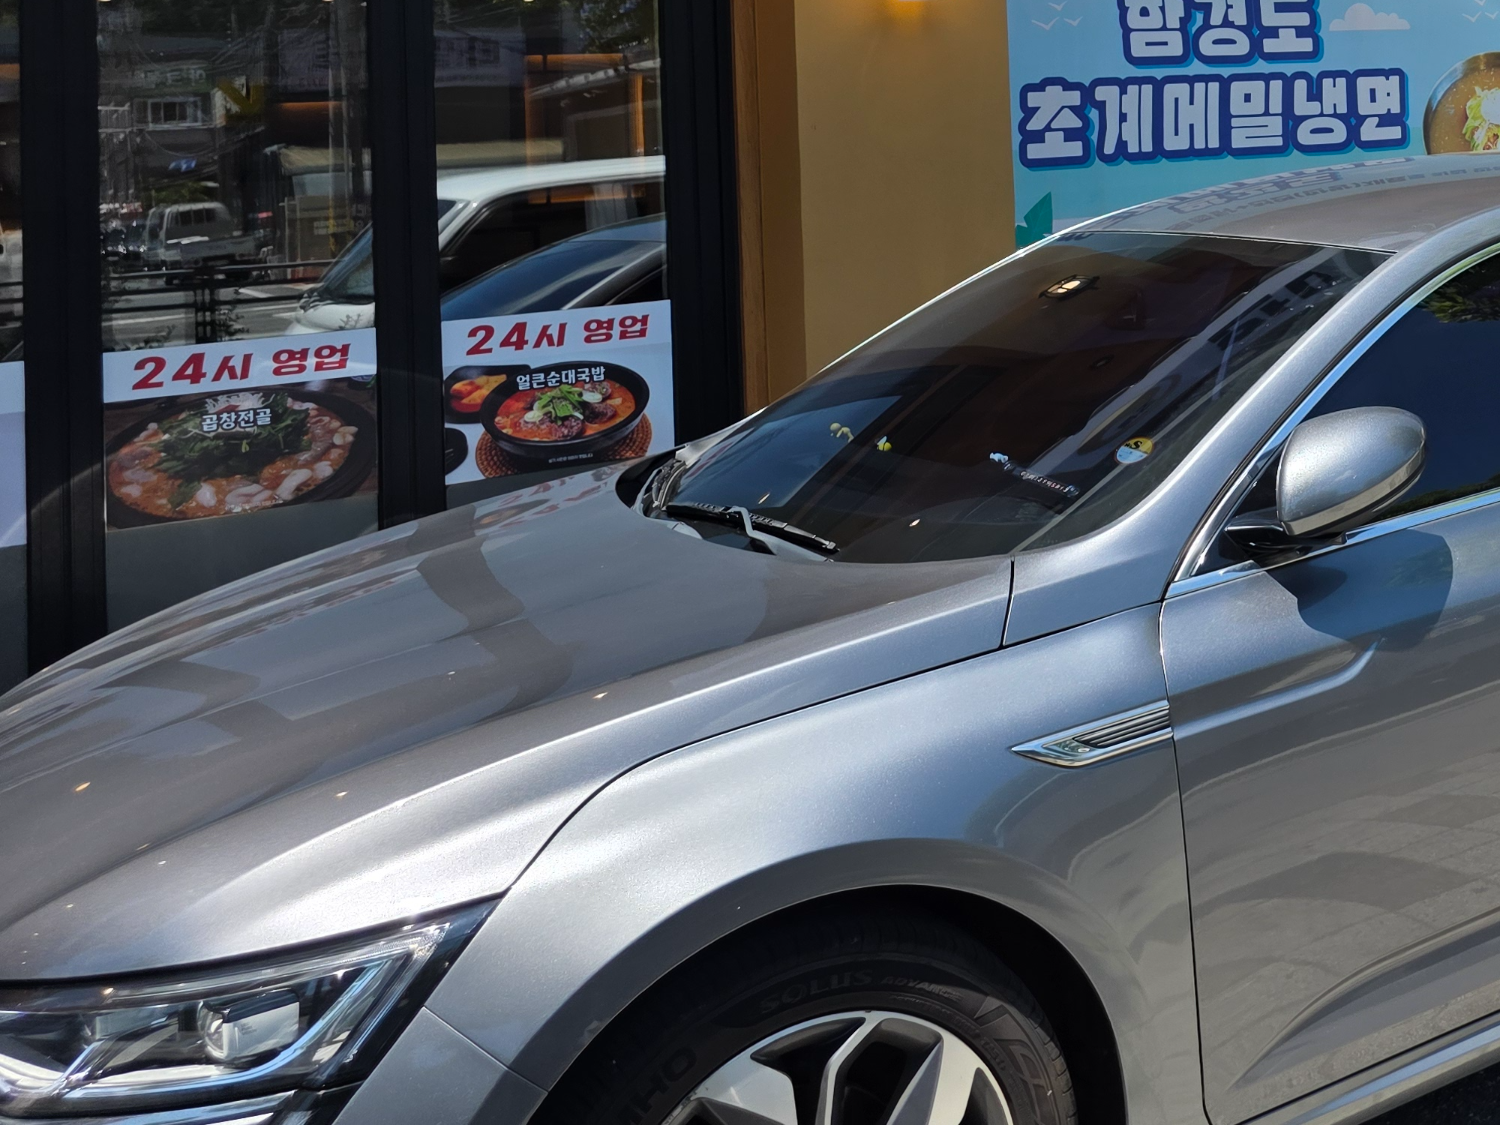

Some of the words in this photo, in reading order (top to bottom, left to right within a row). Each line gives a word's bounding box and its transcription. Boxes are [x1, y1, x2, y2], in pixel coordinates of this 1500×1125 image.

[1021, 71, 1406, 166] 초계메밀냉면
[465, 320, 566, 357] 24시
[582, 314, 650, 346] 영업
[131, 351, 252, 390] 24시
[272, 343, 351, 377] 영업
[516, 365, 606, 391] 얼큰순대국밥
[202, 408, 272, 432] 곱창전골
[759, 969, 874, 1014] SOLUS
